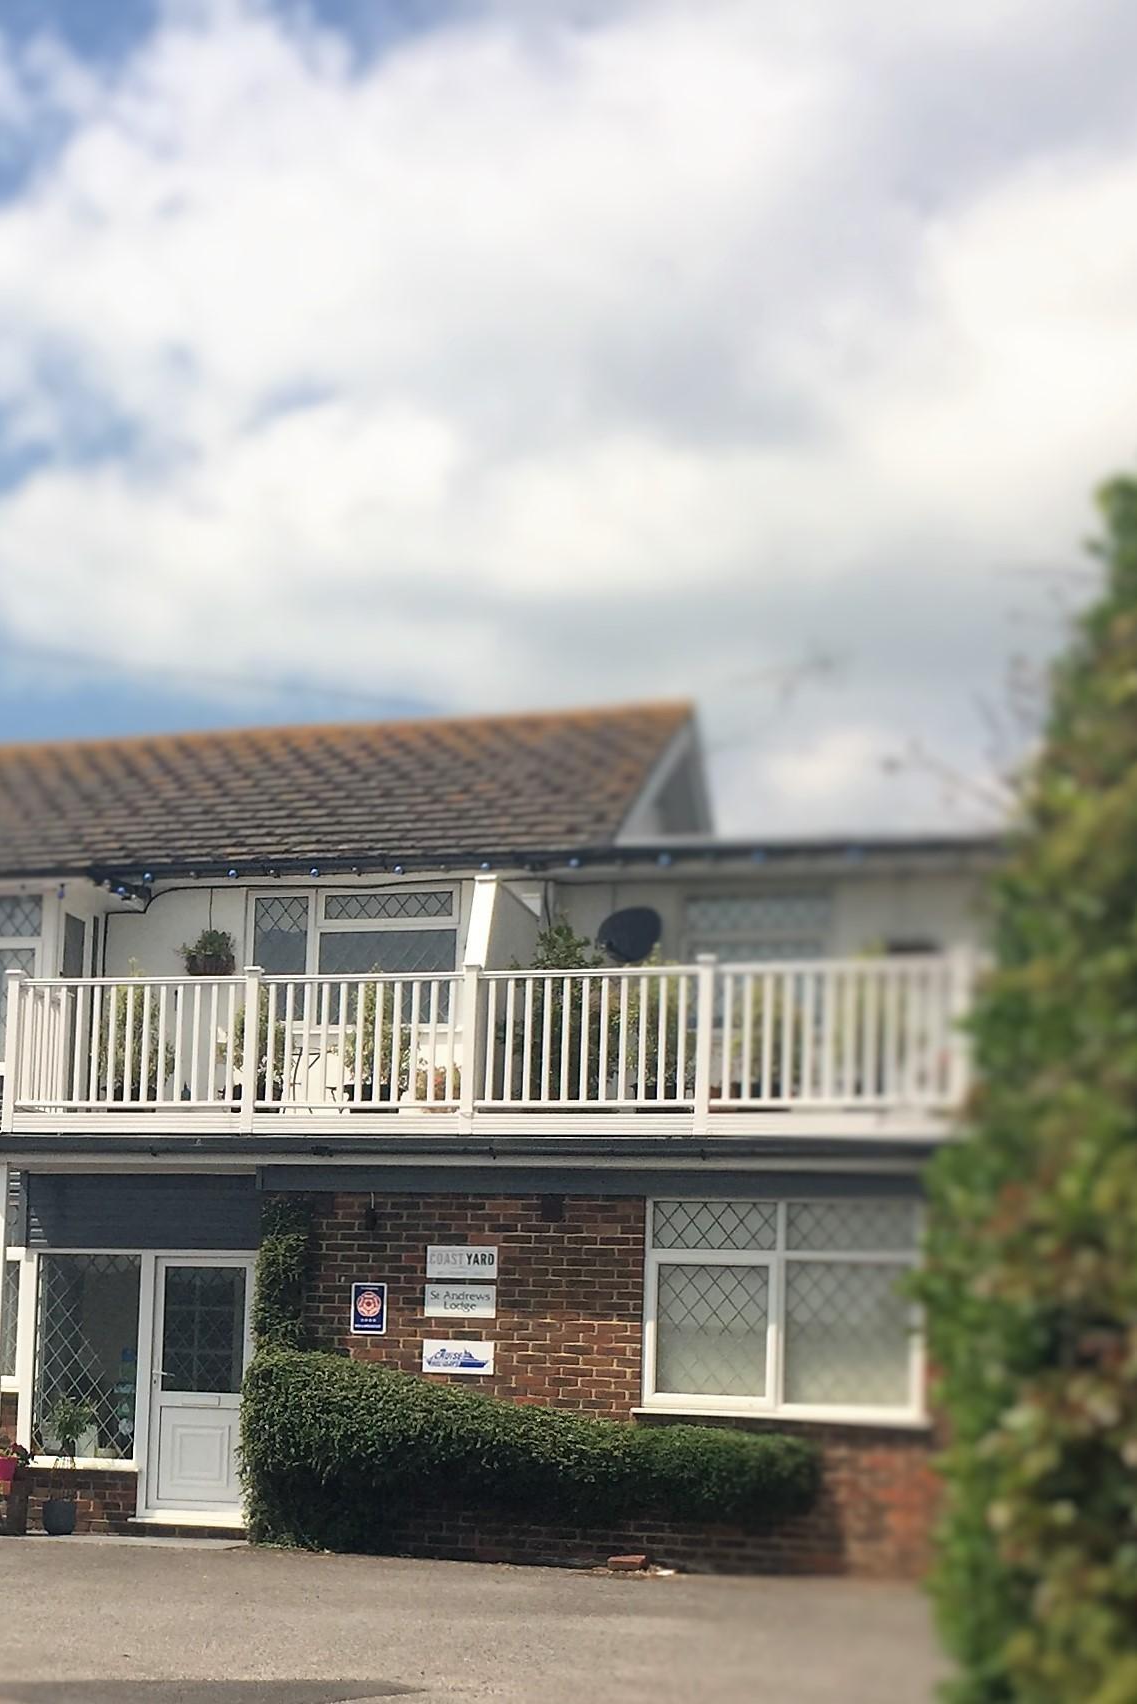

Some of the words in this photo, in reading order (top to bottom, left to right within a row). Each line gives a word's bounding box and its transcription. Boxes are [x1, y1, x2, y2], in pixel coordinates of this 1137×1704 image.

[429, 1253, 464, 1265] COAST
[466, 1252, 495, 1266] YARD
[443, 1290, 491, 1301] Andrews
[443, 1301, 477, 1312] Lodge
